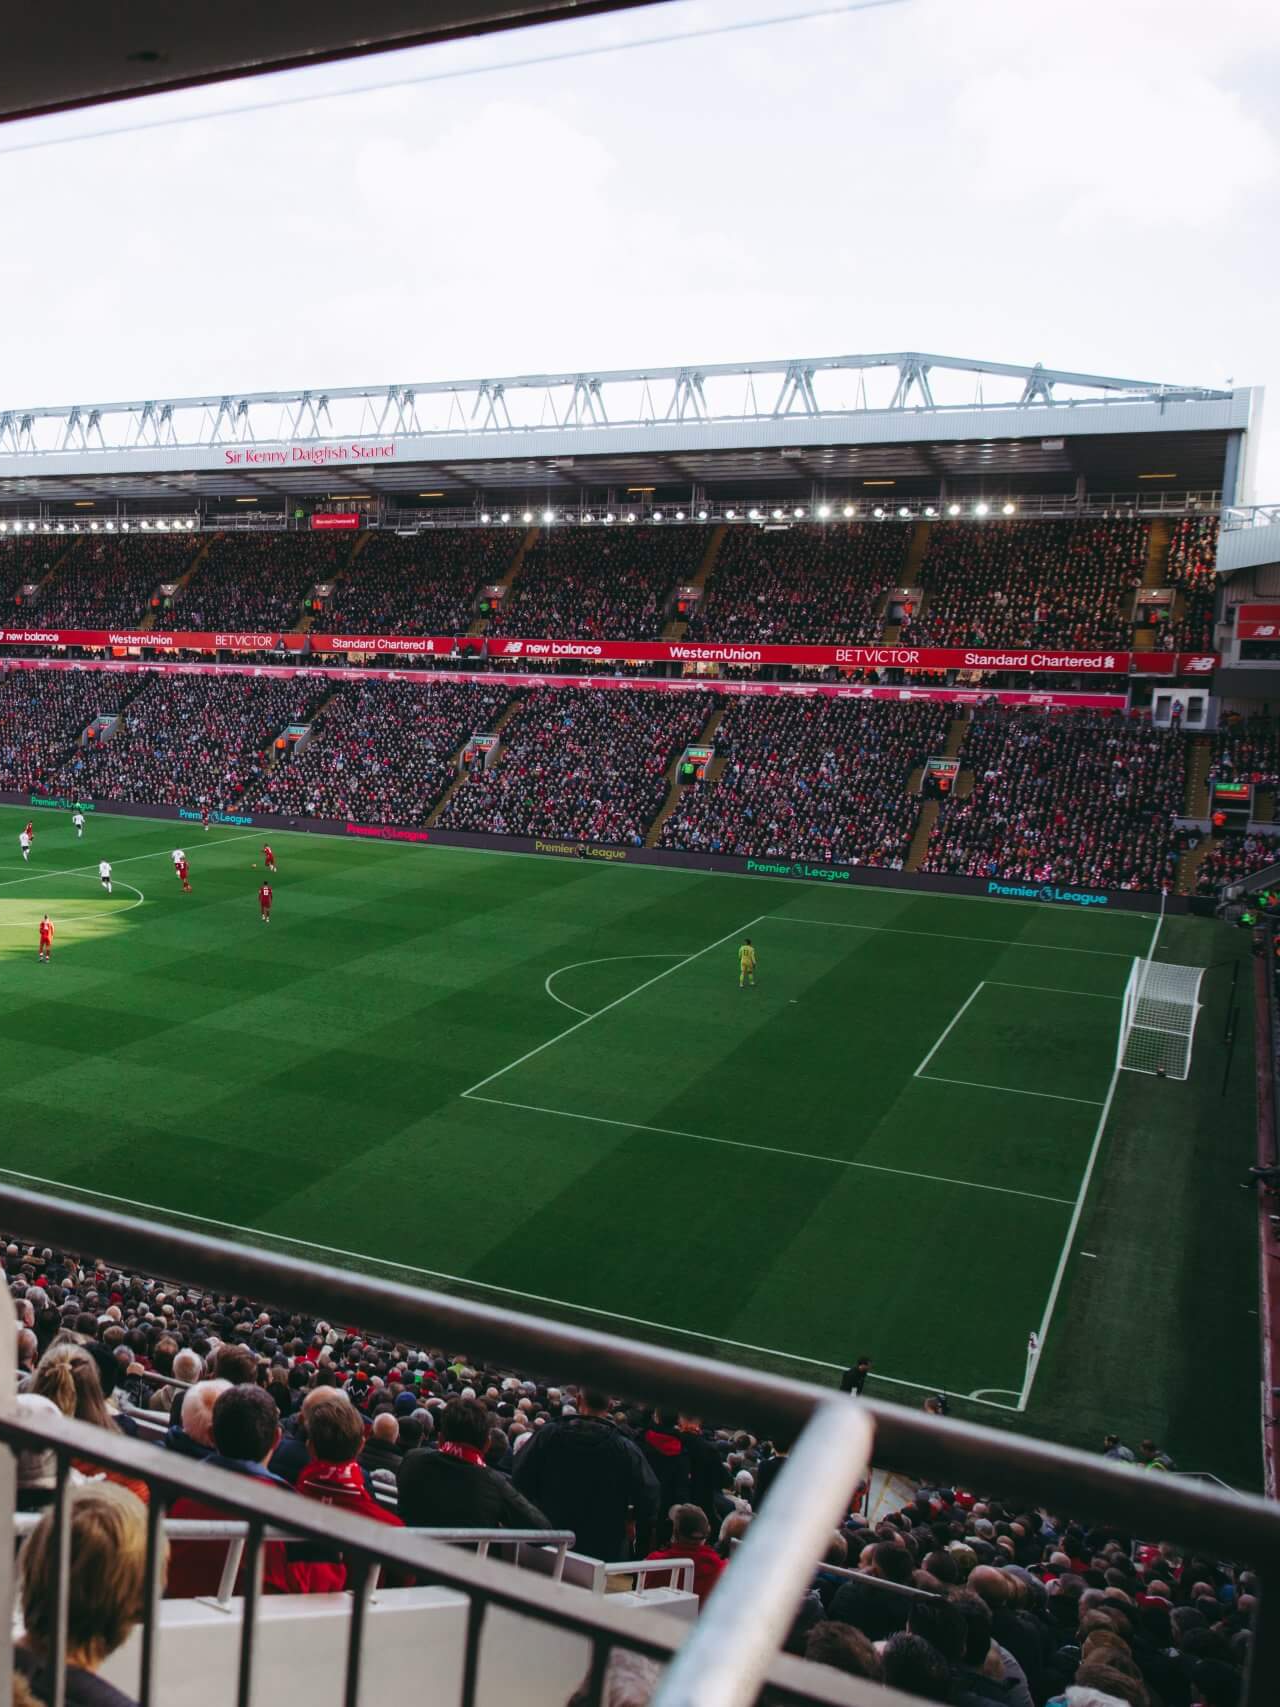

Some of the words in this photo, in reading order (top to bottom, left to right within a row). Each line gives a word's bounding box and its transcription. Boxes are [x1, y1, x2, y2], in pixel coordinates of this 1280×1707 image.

[225, 450, 242, 465] Sir
[246, 449, 288, 464] Kenny
[351, 443, 395, 459] Stand
[6, 633, 22, 641] new
[24, 632, 59, 641] balance
[109, 634, 172, 645] WesternUnion
[215, 635, 272, 646] BETVICTOR
[332, 638, 375, 648] Standard
[377, 639, 425, 650] Chartered
[526, 644, 549, 654] new
[552, 643, 602, 655] balance
[670, 646, 761, 660] WesternUnion
[836, 649, 919, 663] BETVICTOR
[965, 653, 1027, 666] Standard
[1030, 654, 1102, 668] Chartered
[221, 812, 253, 825] League
[535, 841, 576, 854] Premier
[586, 845, 626, 859] League
[747, 860, 791, 874] Premier
[804, 865, 850, 880] League
[988, 882, 1039, 897] Premier
[1055, 888, 1108, 905] League
